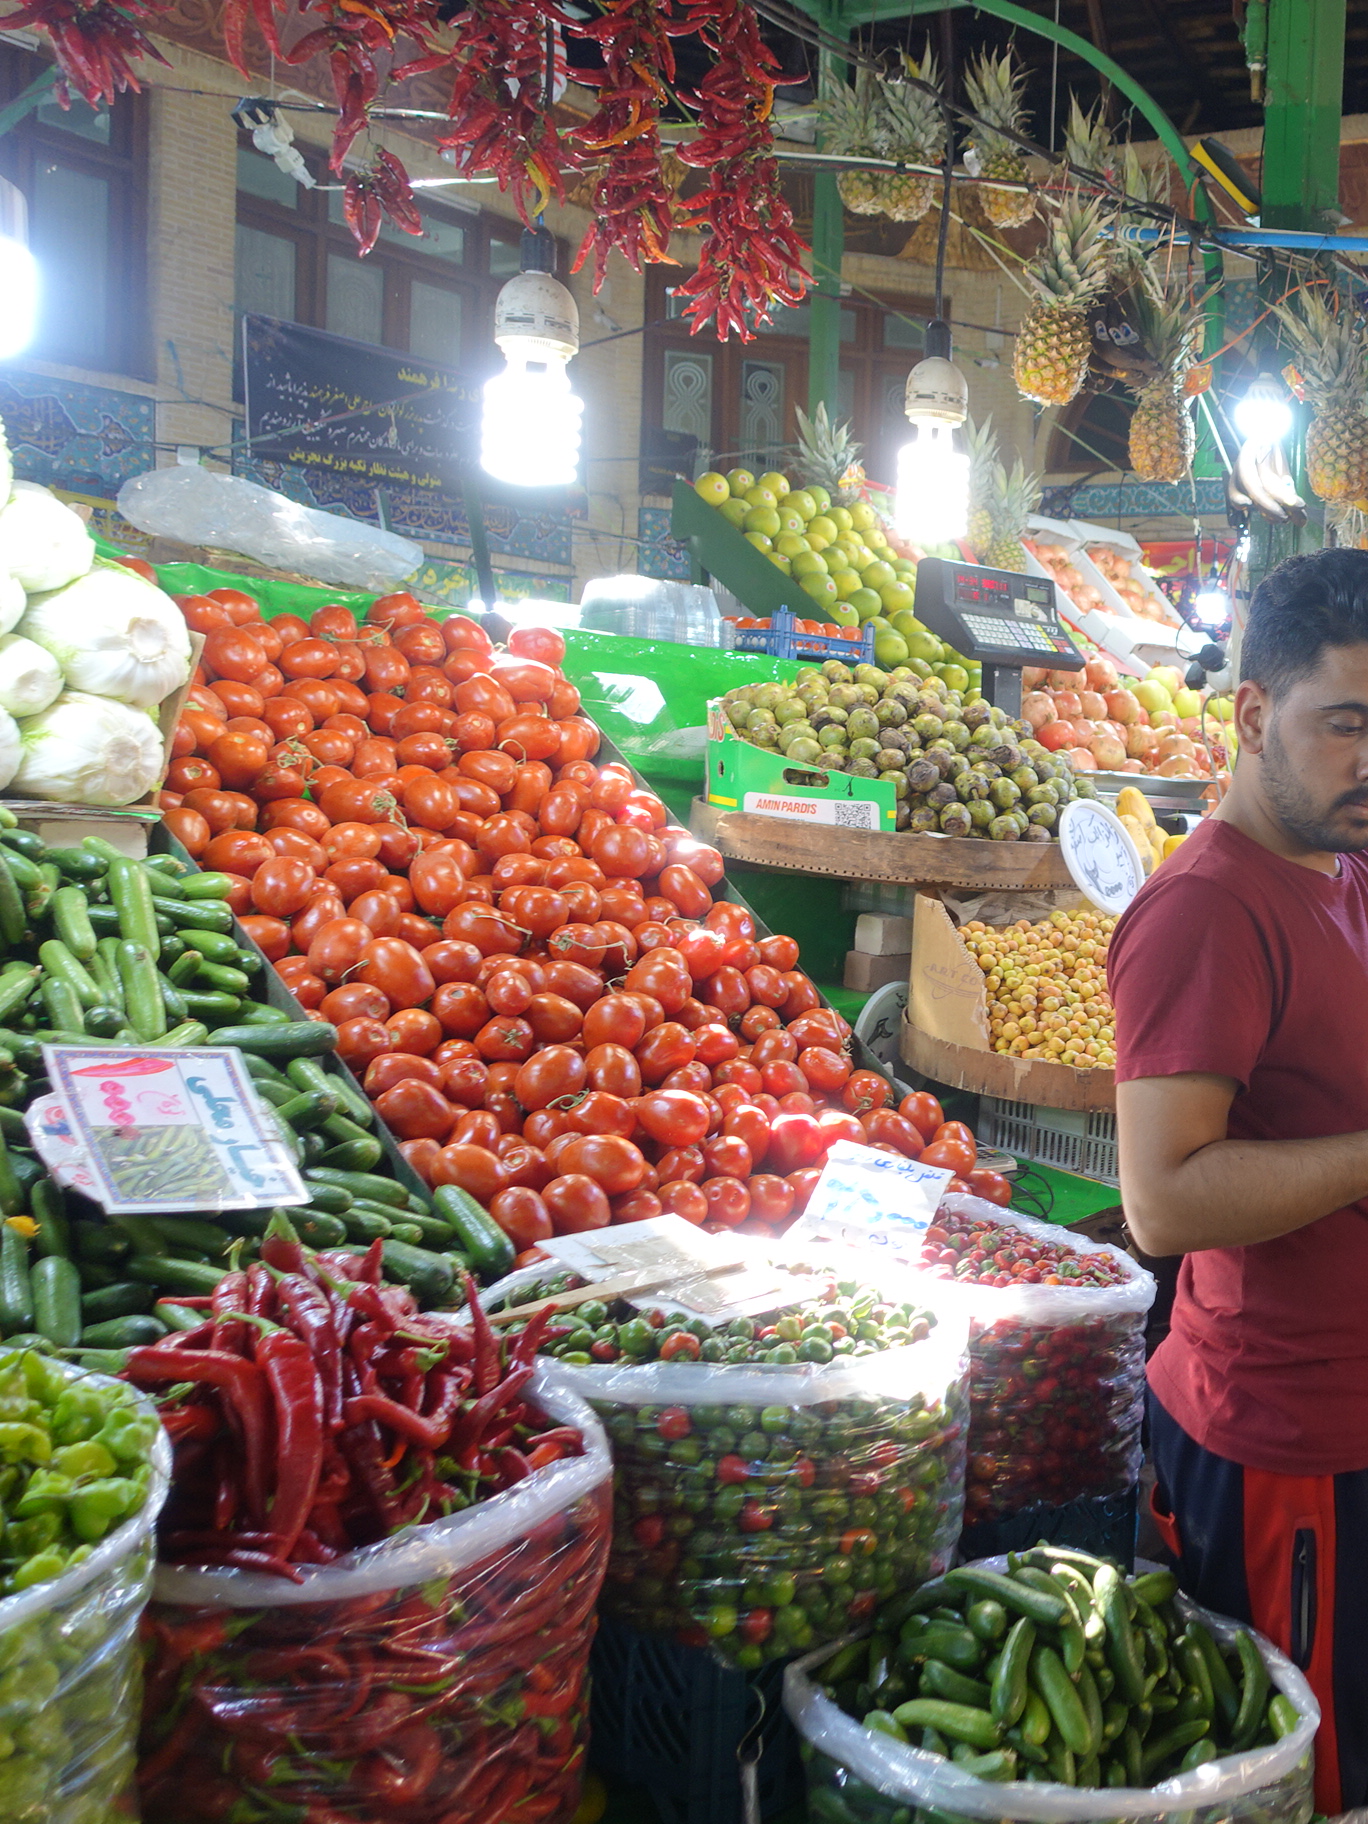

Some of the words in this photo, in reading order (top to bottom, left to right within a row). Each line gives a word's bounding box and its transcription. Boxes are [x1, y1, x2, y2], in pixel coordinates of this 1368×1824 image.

[781, 801, 817, 815] PARDIS
[185, 1076, 239, 1129] محلی
[208, 1135, 278, 1188] خیار
